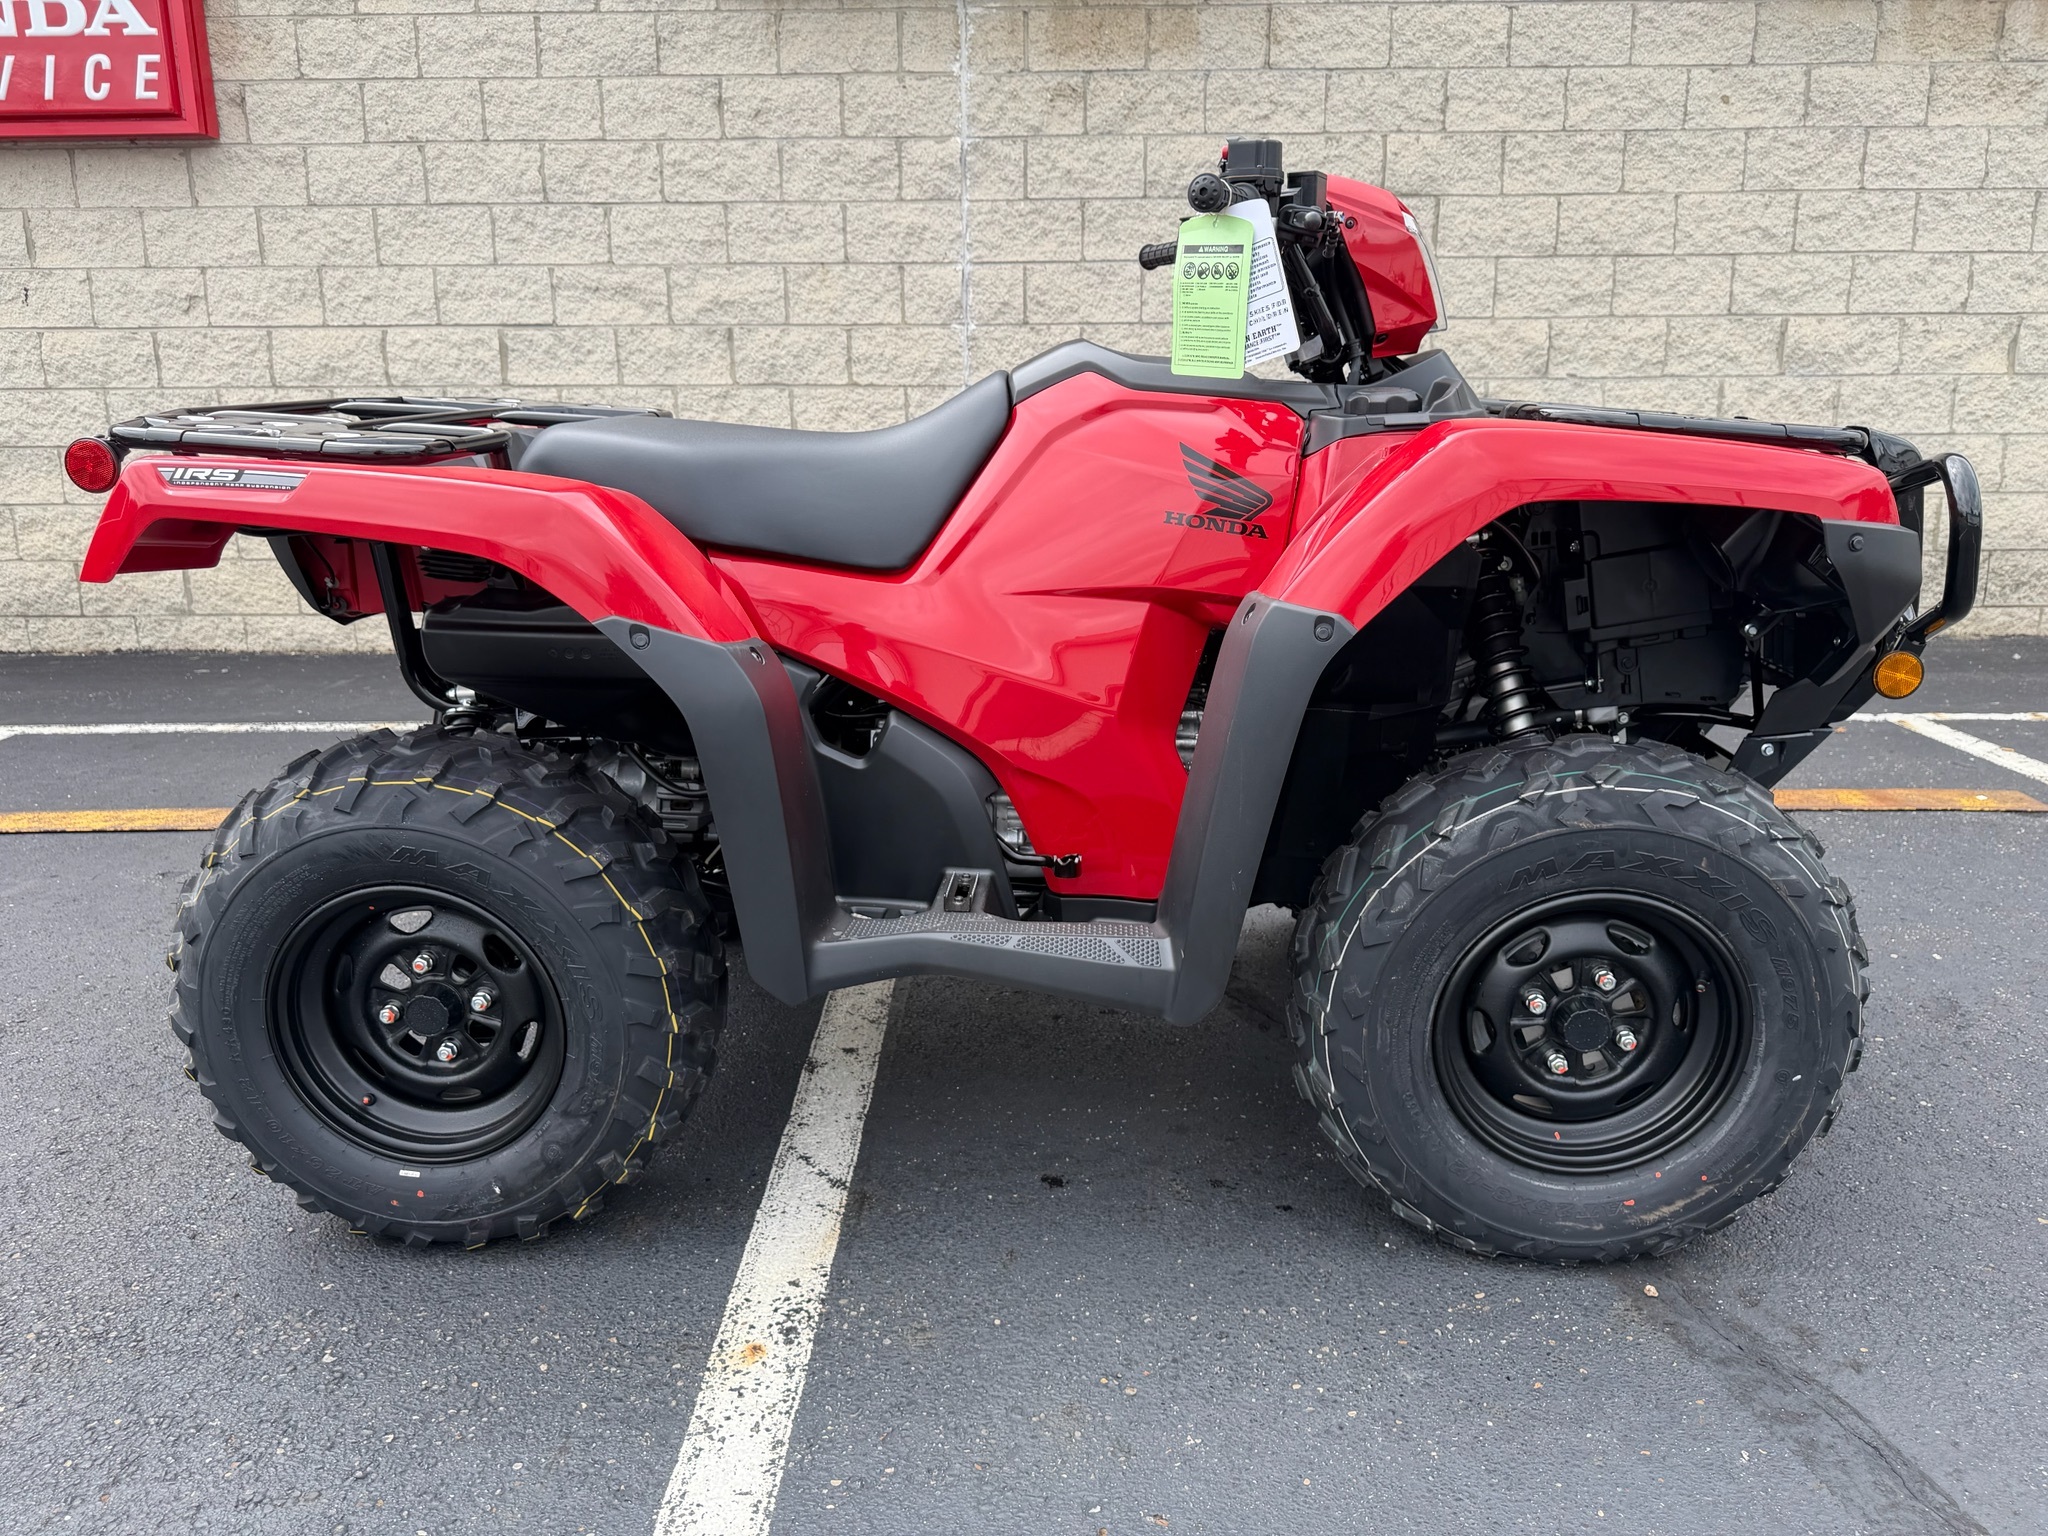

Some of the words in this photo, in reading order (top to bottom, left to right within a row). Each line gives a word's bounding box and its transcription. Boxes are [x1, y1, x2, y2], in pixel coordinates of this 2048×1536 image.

[1249, 306, 1289, 326] CHILDREN
[1250, 304, 1271, 318] SKIES
[173, 468, 240, 480] IRS
[1164, 510, 1268, 540] HONDA
[387, 845, 604, 1022] MAXXIS
[1504, 849, 1778, 944] MAXXIS
[1770, 956, 1800, 1030] M975
